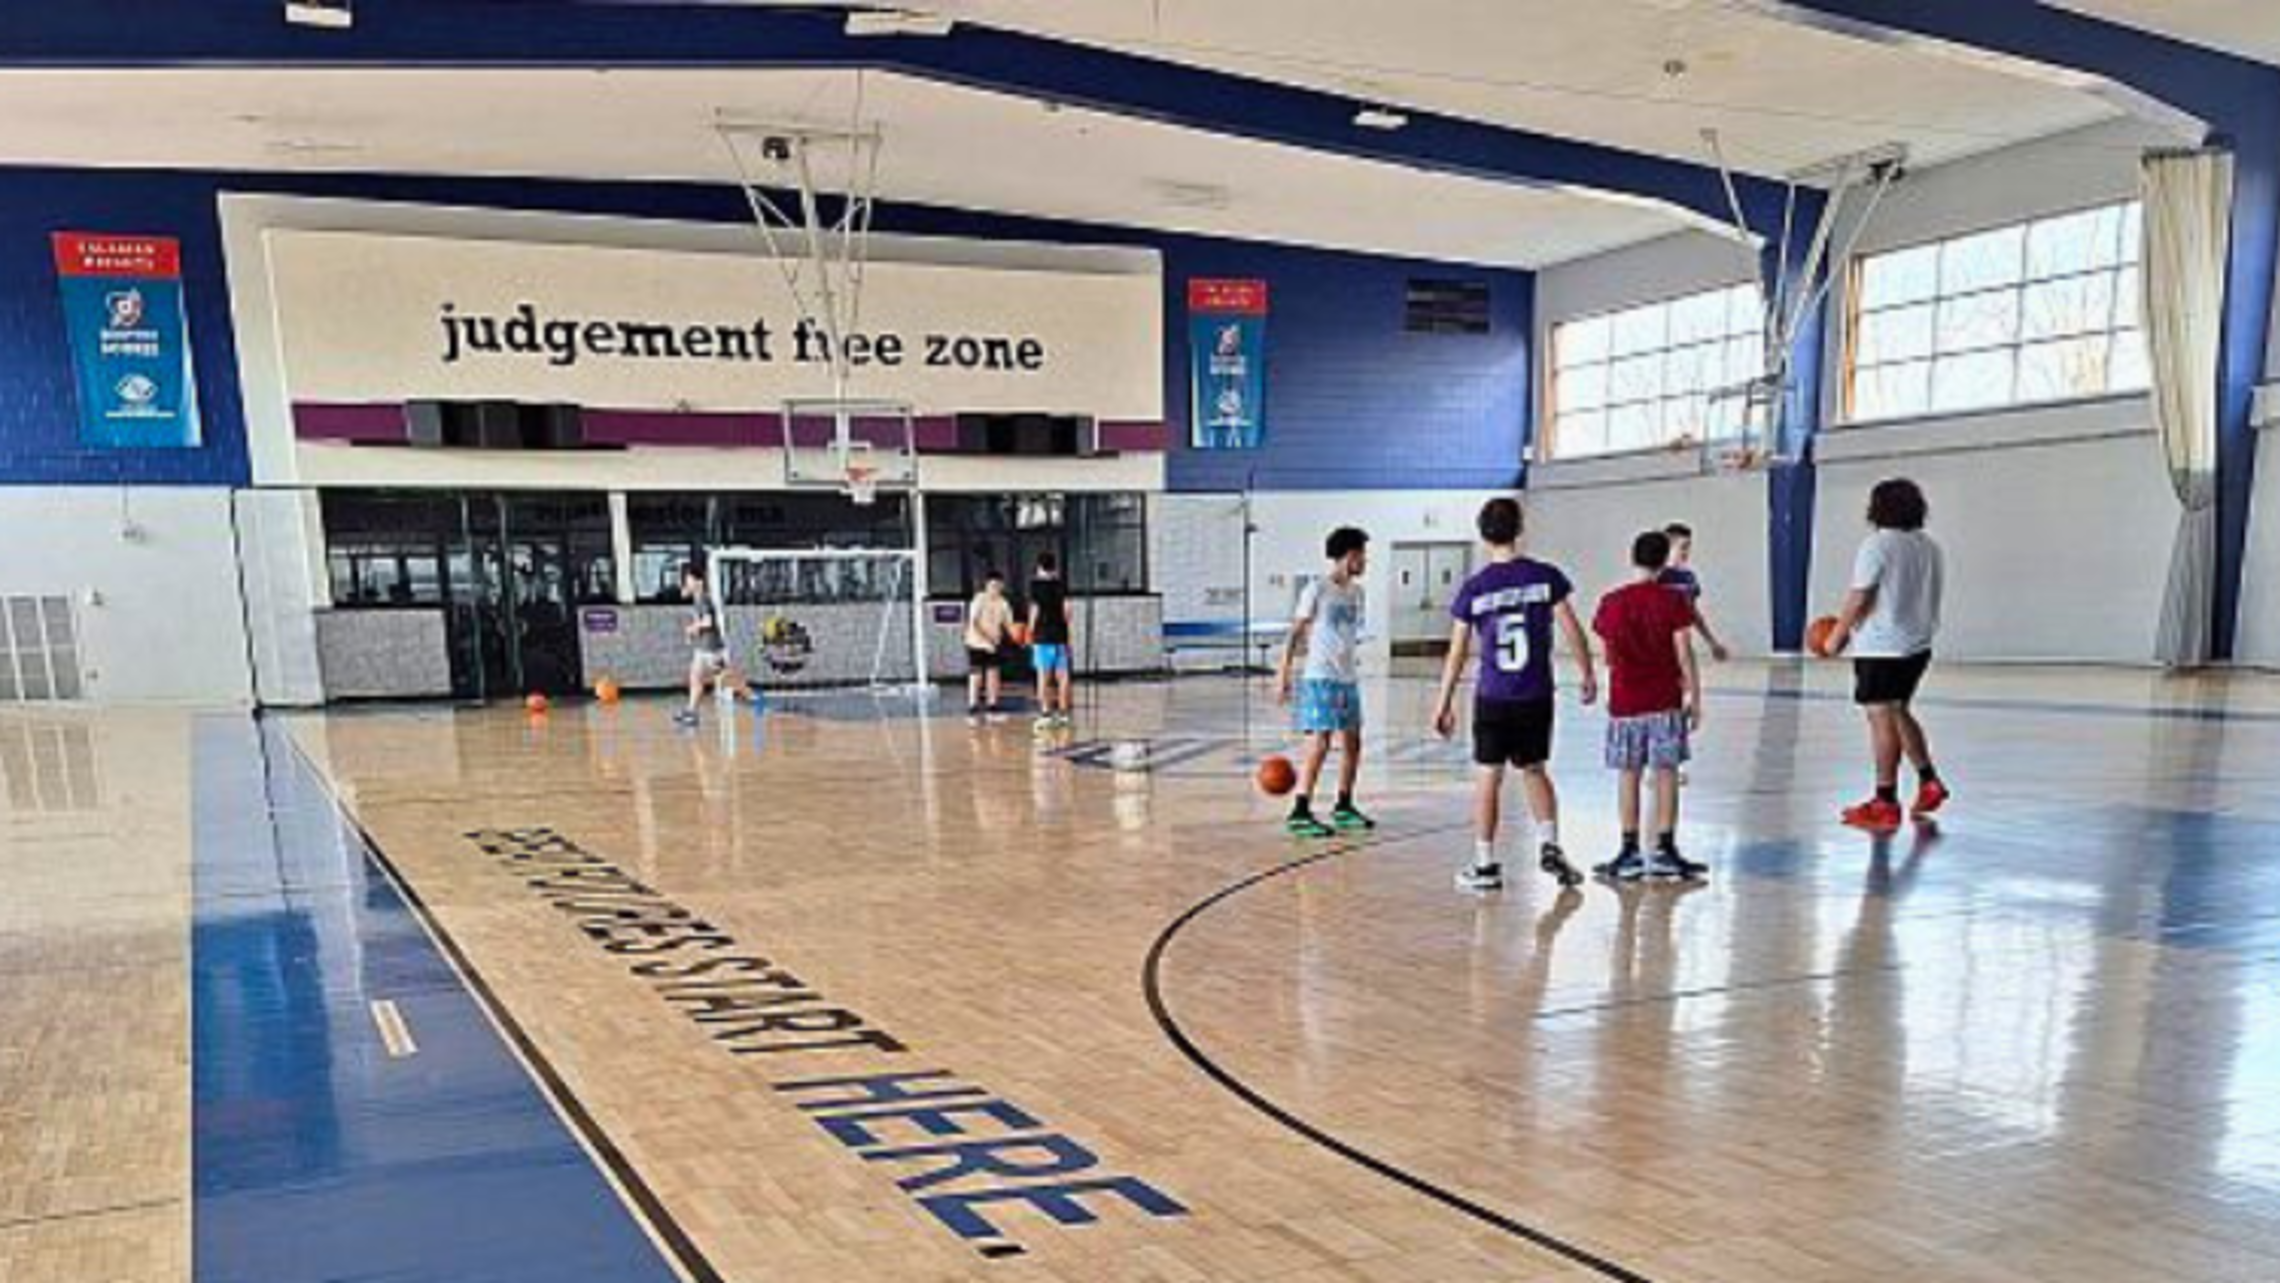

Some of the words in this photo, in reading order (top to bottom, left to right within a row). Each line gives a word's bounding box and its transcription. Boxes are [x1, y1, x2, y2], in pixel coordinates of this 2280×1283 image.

[441, 302, 772, 365] judgement
[925, 331, 1044, 370] zone
[1496, 613, 1529, 671] 5
[629, 956, 909, 1053] START
[771, 1068, 1191, 1258] HERE.
